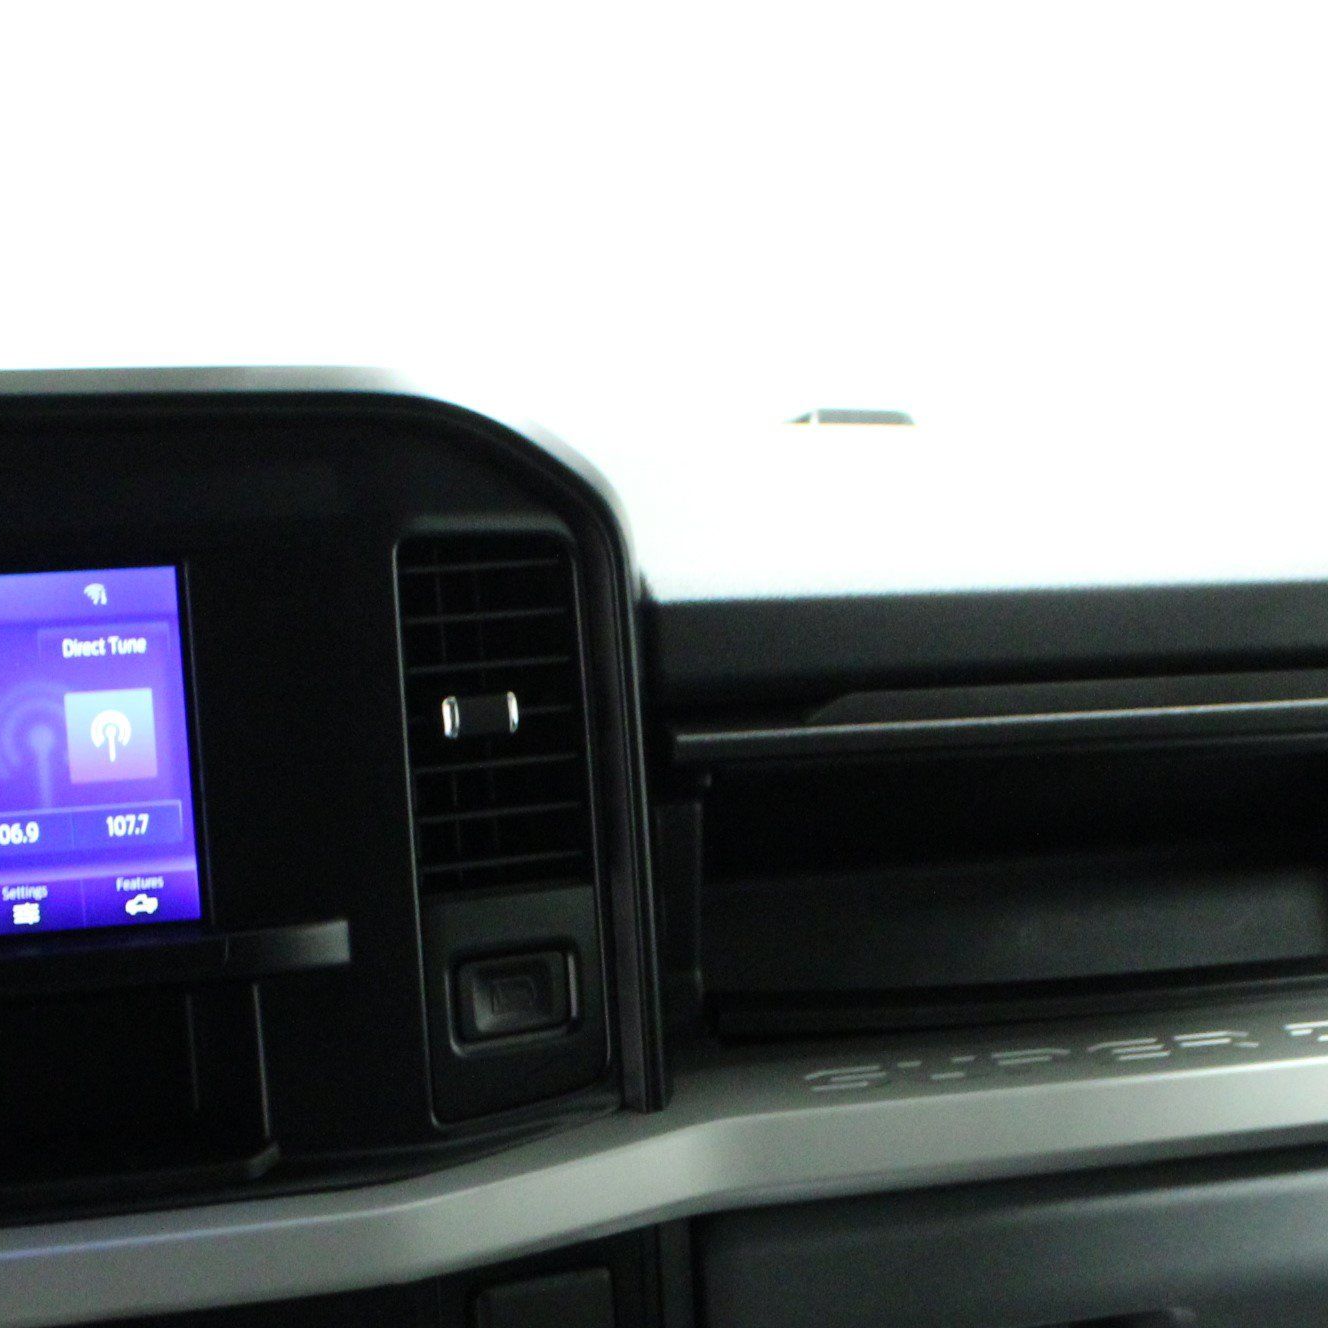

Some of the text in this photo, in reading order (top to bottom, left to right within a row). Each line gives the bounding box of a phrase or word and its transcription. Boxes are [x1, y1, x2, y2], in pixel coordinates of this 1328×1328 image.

[62, 636, 147, 658] Direct Tune
[106, 814, 150, 837] 107.7
[2, 883, 48, 904] Settings
[116, 874, 164, 892] Features
